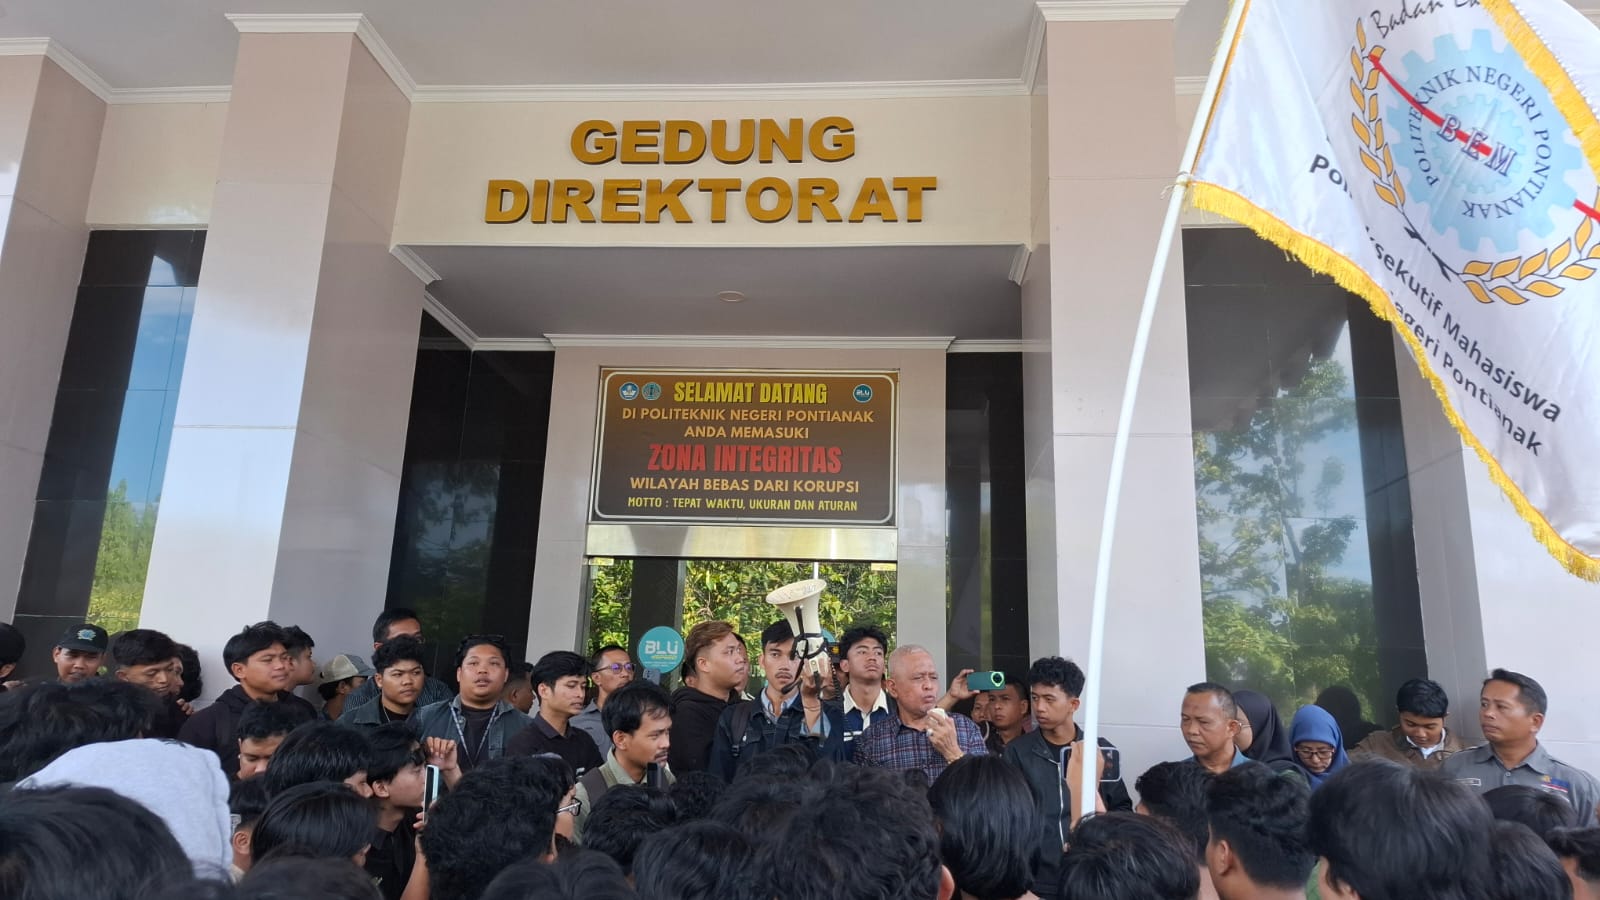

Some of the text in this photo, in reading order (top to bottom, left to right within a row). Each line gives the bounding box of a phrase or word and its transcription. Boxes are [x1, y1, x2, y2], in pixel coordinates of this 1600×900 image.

[570, 116, 856, 165] GEDUNG
[1408, 66, 1552, 219] POLITEKNIK NEGERI PONTIANAK
[1436, 114, 1517, 178] BEM
[484, 176, 937, 224] DIREKTORAT
[1365, 226, 1562, 423] sekutif Mahasiswa
[673, 381, 827, 404] SELAMAT DATANG
[1443, 351, 1543, 456] Pontianak
[622, 407, 874, 423] DI POLITEKNIK NEGERI PONTIANAK
[684, 425, 809, 439] ANDA MEMASUKI
[647, 443, 842, 474] ZONA INTEGRITAS
[630, 476, 860, 493] WILAYAH BEBAS DARI KORUPSI
[628, 496, 662, 508] MOTTO
[672, 497, 702, 509] TEPAT
[705, 498, 746, 510] WAKTU,
[749, 498, 791, 510] UKURAN
[794, 499, 814, 510] DAN
[818, 499, 857, 511] ATURAN
[645, 640, 679, 655] BLU
